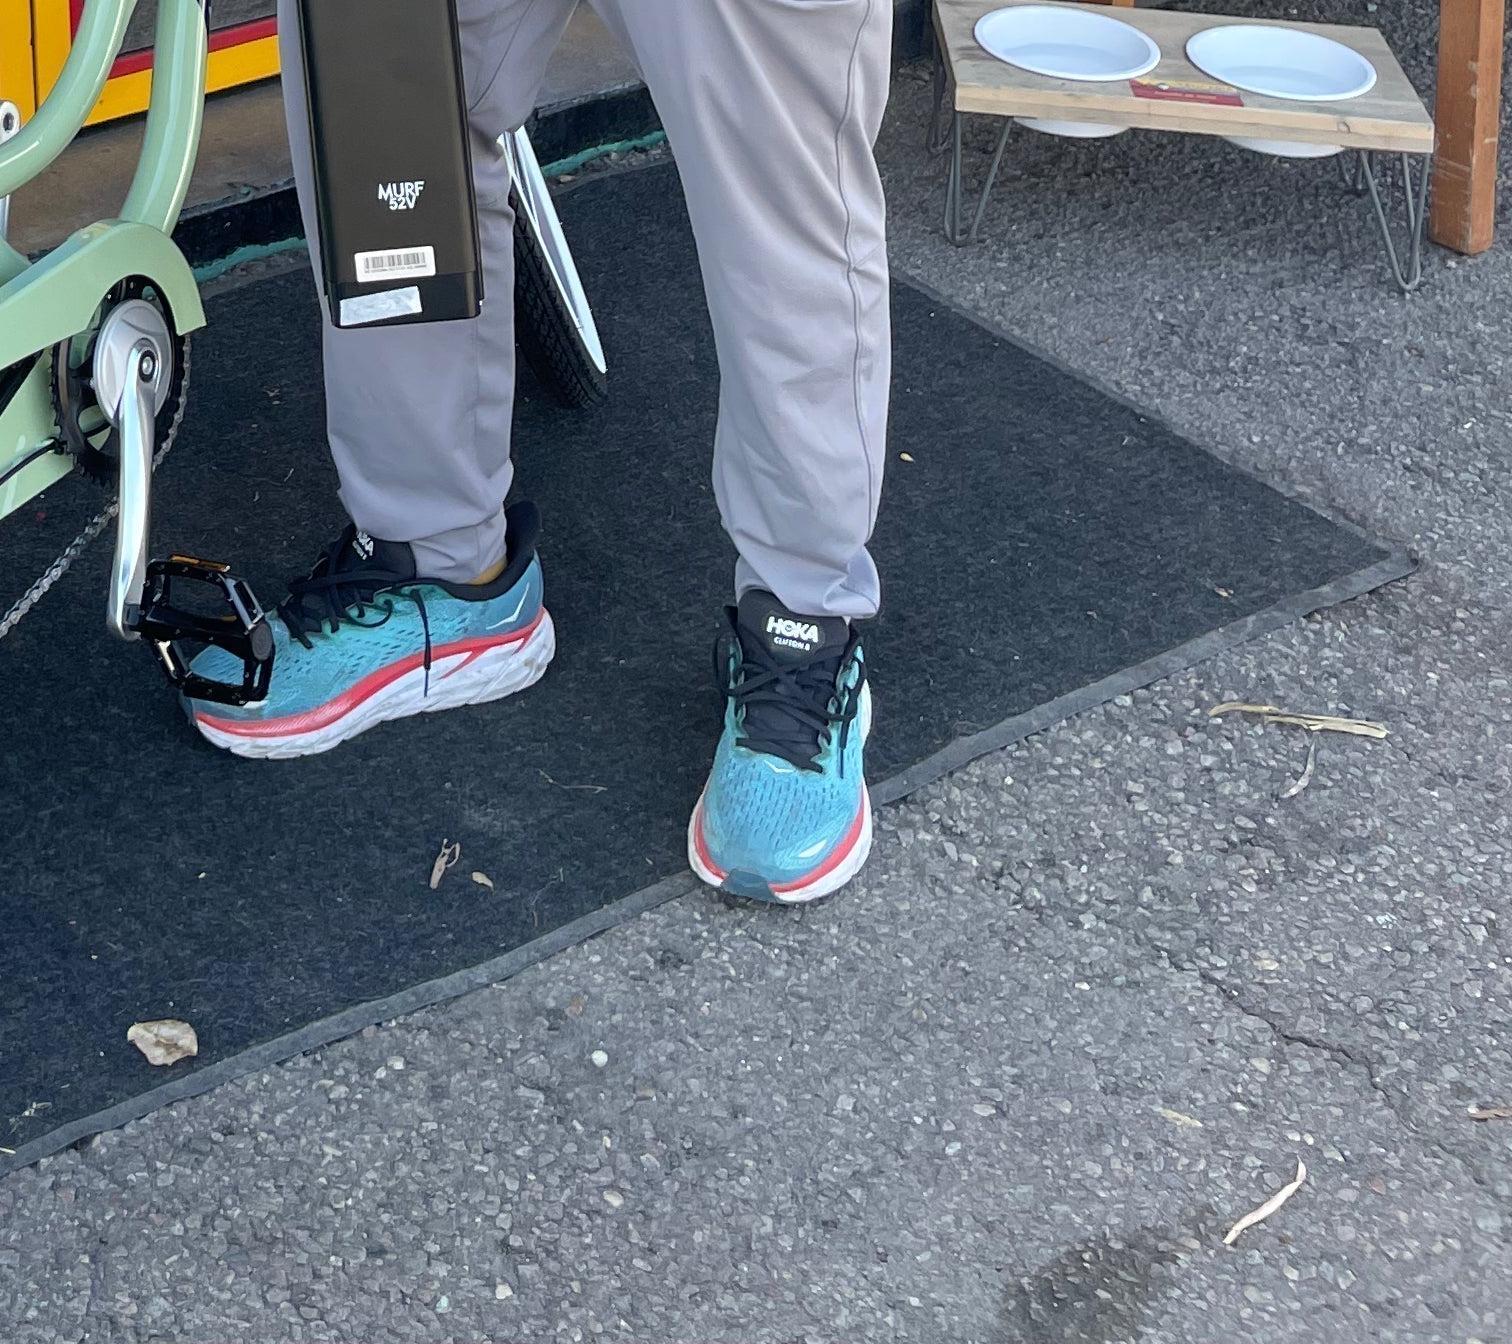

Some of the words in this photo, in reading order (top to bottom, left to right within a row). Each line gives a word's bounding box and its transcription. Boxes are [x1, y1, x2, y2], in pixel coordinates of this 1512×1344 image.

[378, 180, 425, 202] MURF
[389, 195, 418, 211] 52V
[766, 616, 819, 643] HOKA
